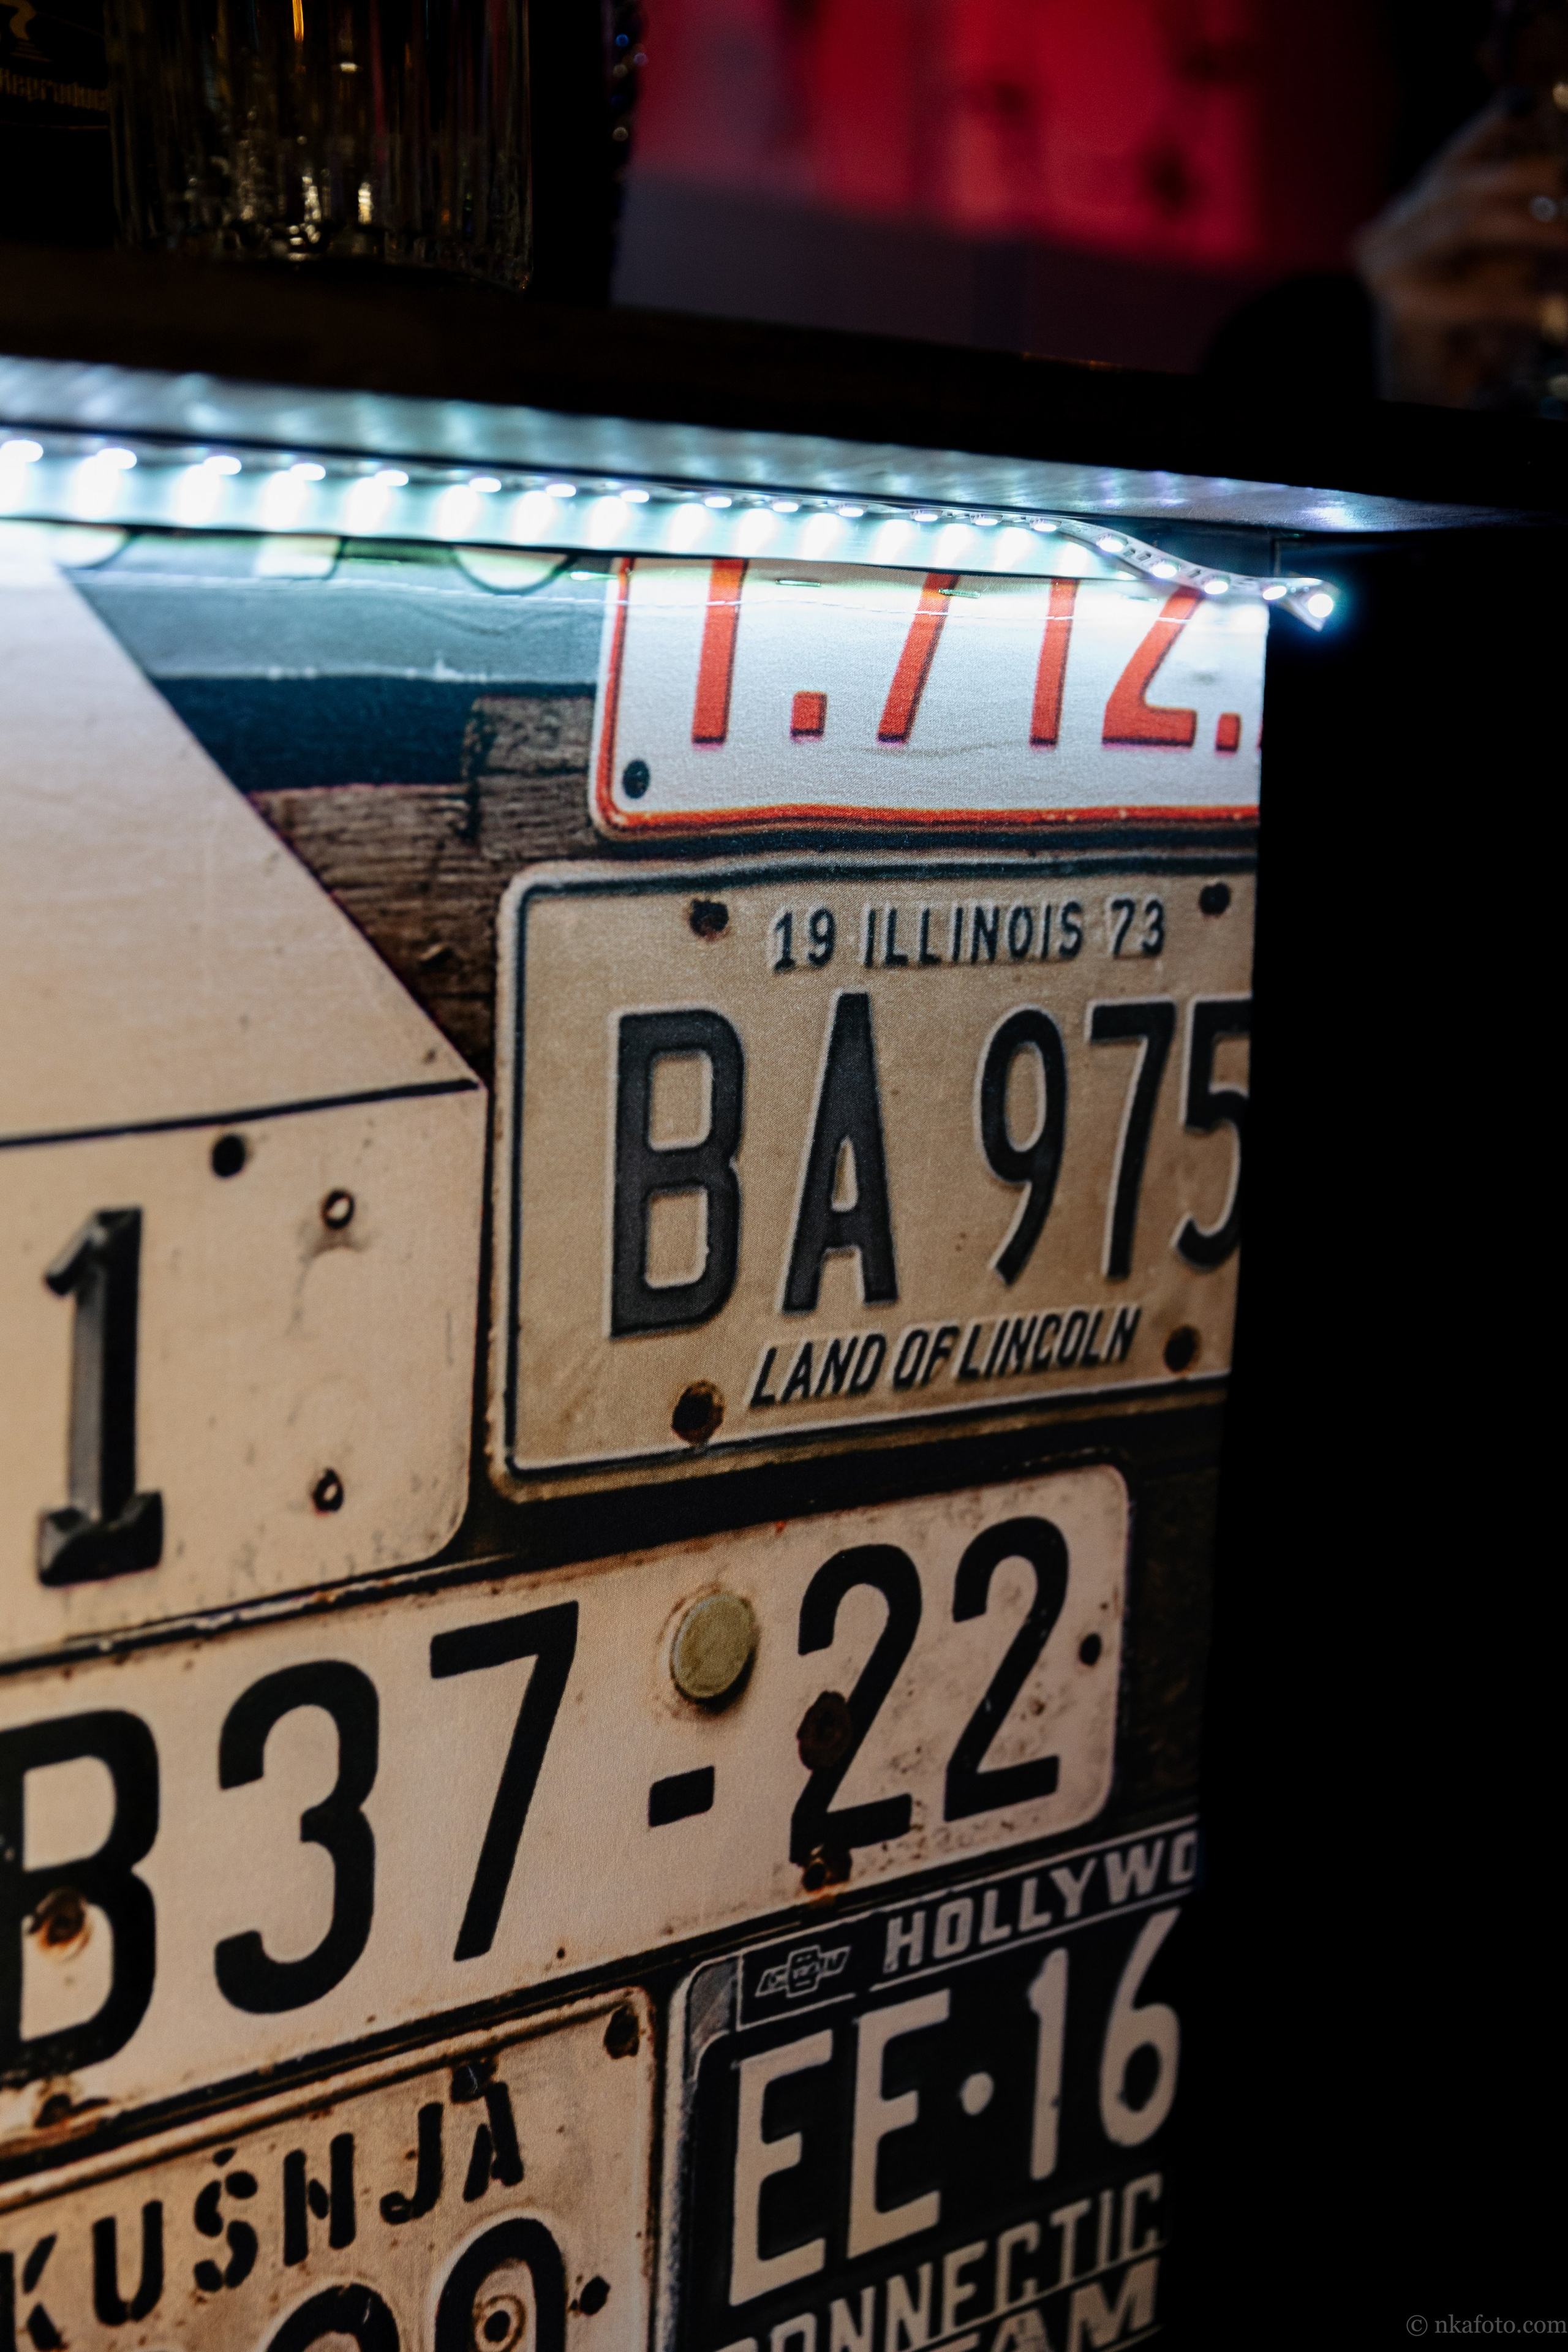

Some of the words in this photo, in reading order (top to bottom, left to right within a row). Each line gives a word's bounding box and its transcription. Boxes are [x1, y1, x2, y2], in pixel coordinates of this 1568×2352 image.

[774, 909, 835, 970] 19
[864, 901, 1083, 968] ILLINOIS
[1111, 898, 1164, 960] 73
[612, 992, 898, 1336] BA
[981, 1000, 1253, 1283] 975
[38, 1208, 163, 1587] 1
[749, 1333, 885, 1408] LAND
[892, 1325, 959, 1389] OF
[958, 1306, 1142, 1379] LINCOLN
[883, 1828, 1199, 1975] HOLLYWO
